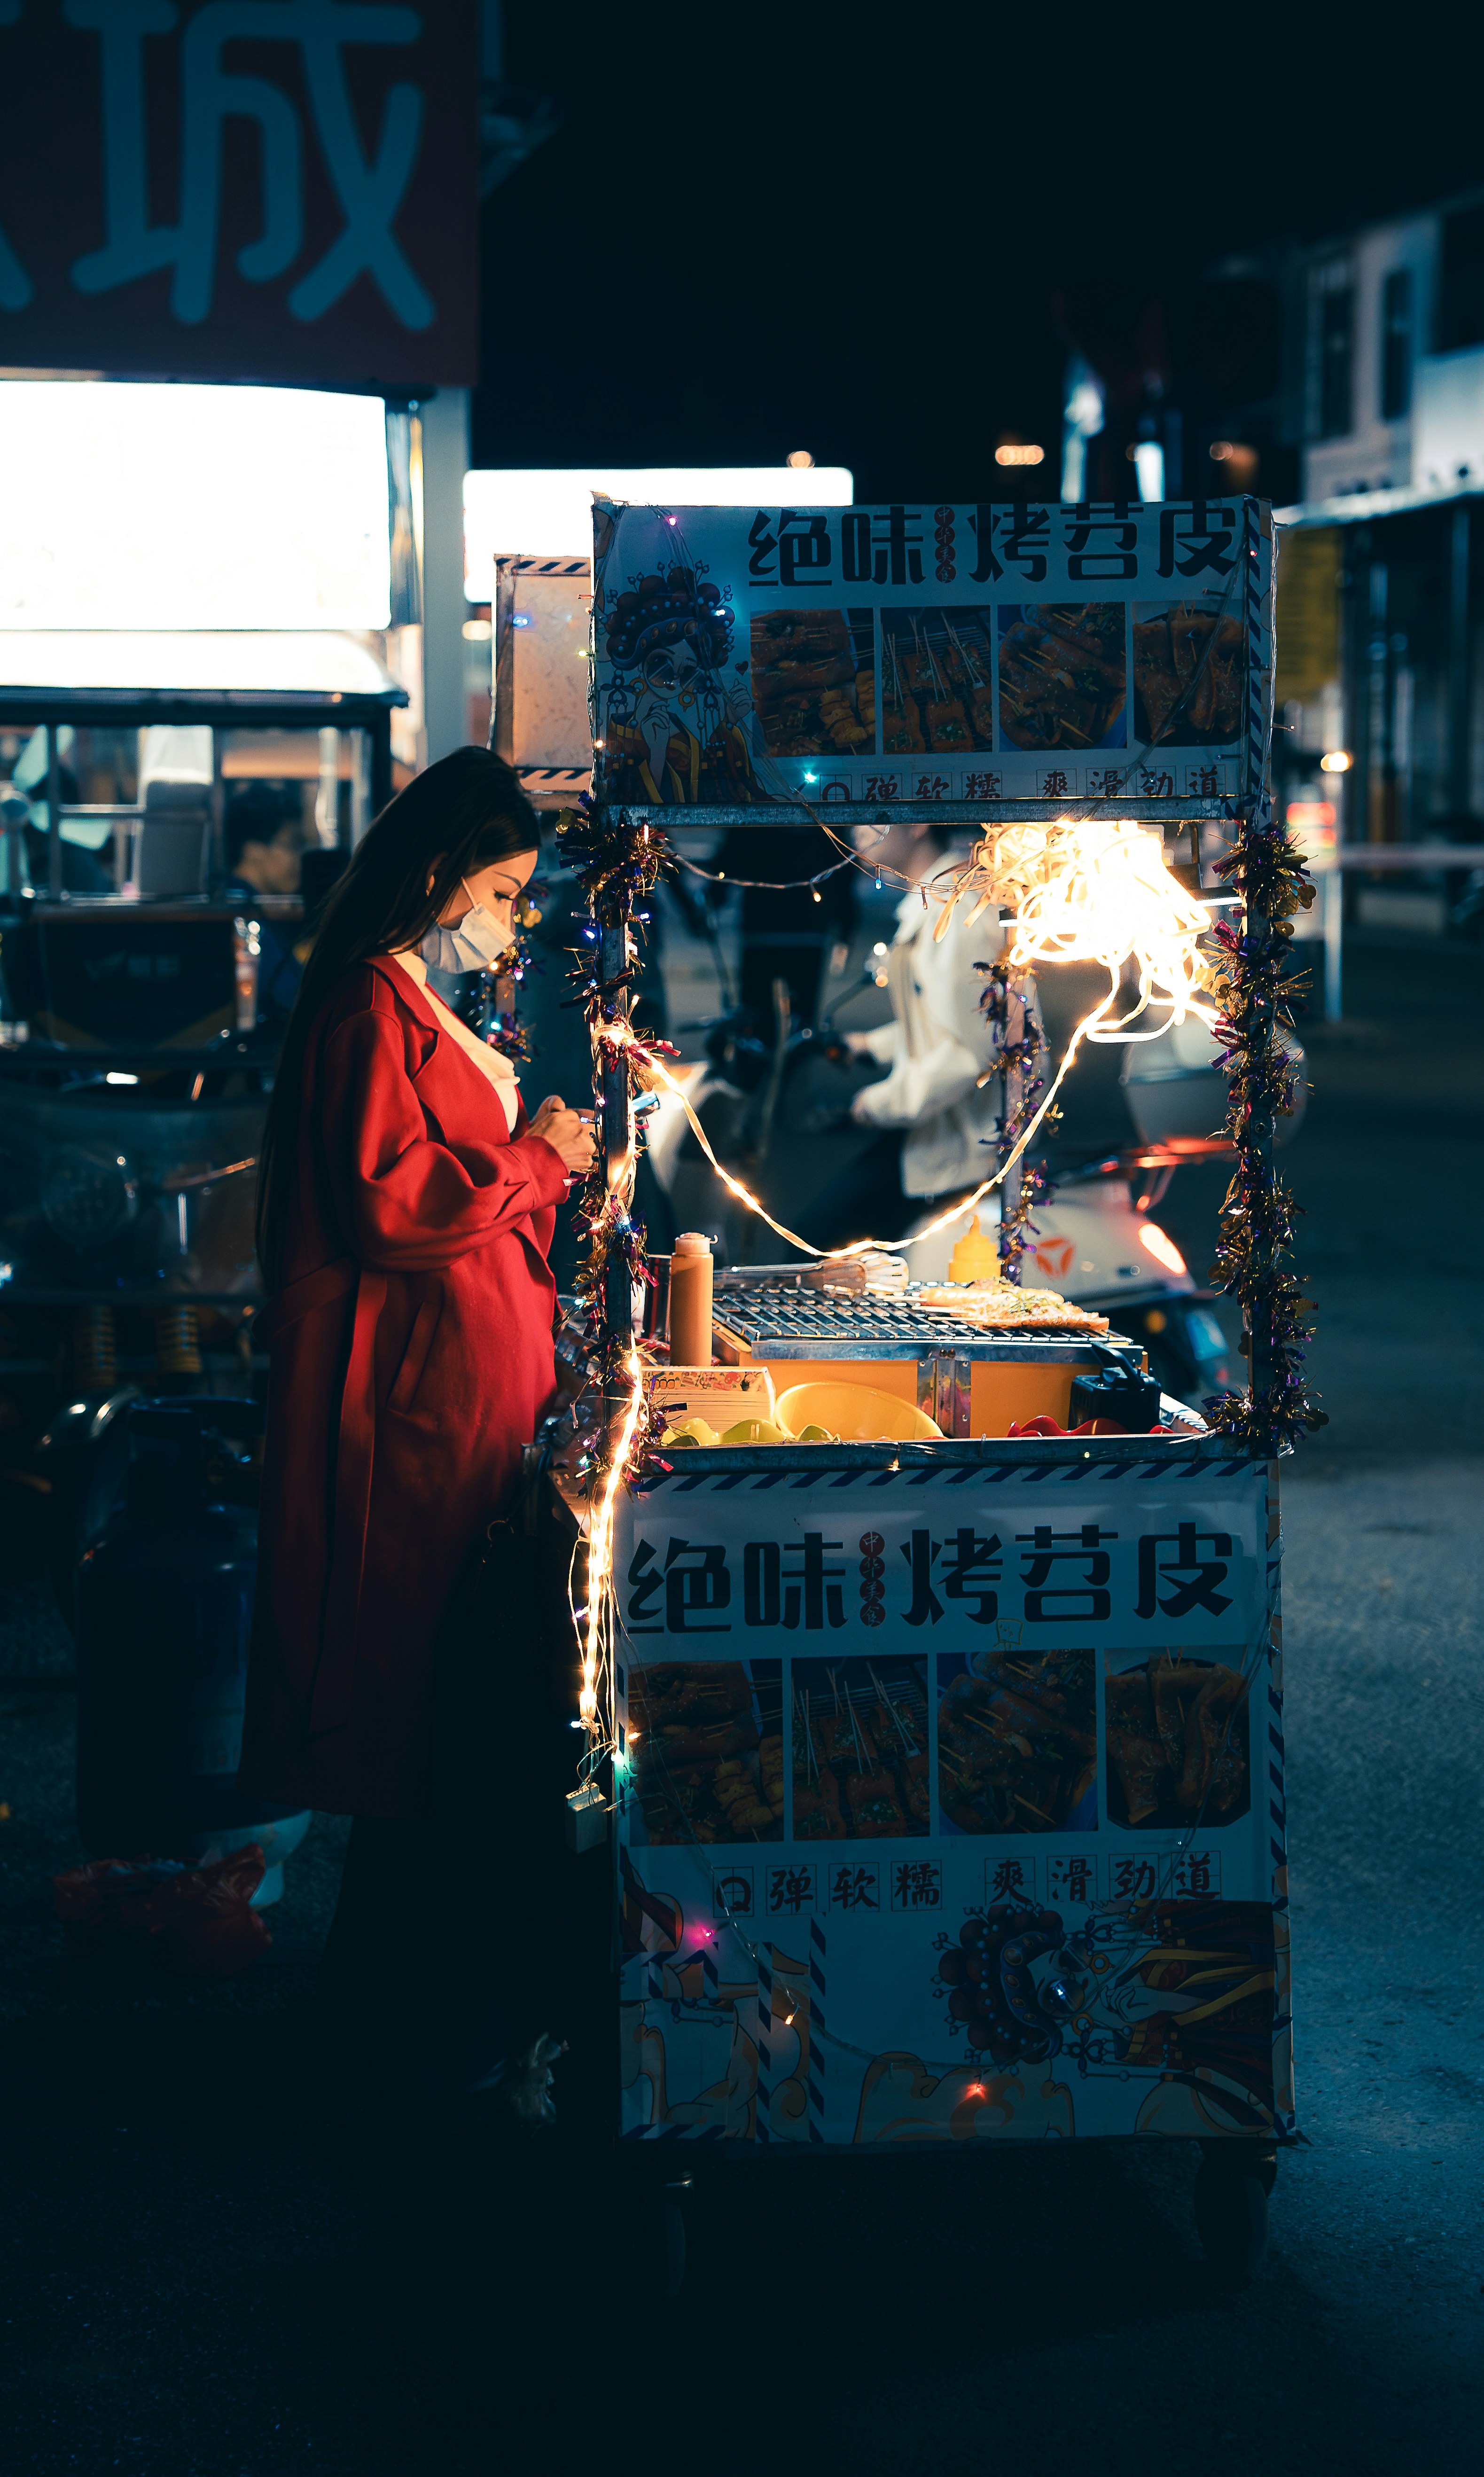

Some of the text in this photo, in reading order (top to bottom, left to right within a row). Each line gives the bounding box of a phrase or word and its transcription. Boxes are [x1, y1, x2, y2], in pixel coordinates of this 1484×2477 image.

[0, 0, 436, 331] 城
[748, 501, 1237, 586] 绝味 烤苕皮
[934, 506, 957, 583] 中华美食
[1033, 766, 1217, 797] 爽滑劲道
[627, 1522, 1234, 1633] 绝味 烤苕皮
[859, 1531, 885, 1627] 中华美食
[716, 1852, 1221, 1912] Q弹软糯 爽滑劲道
